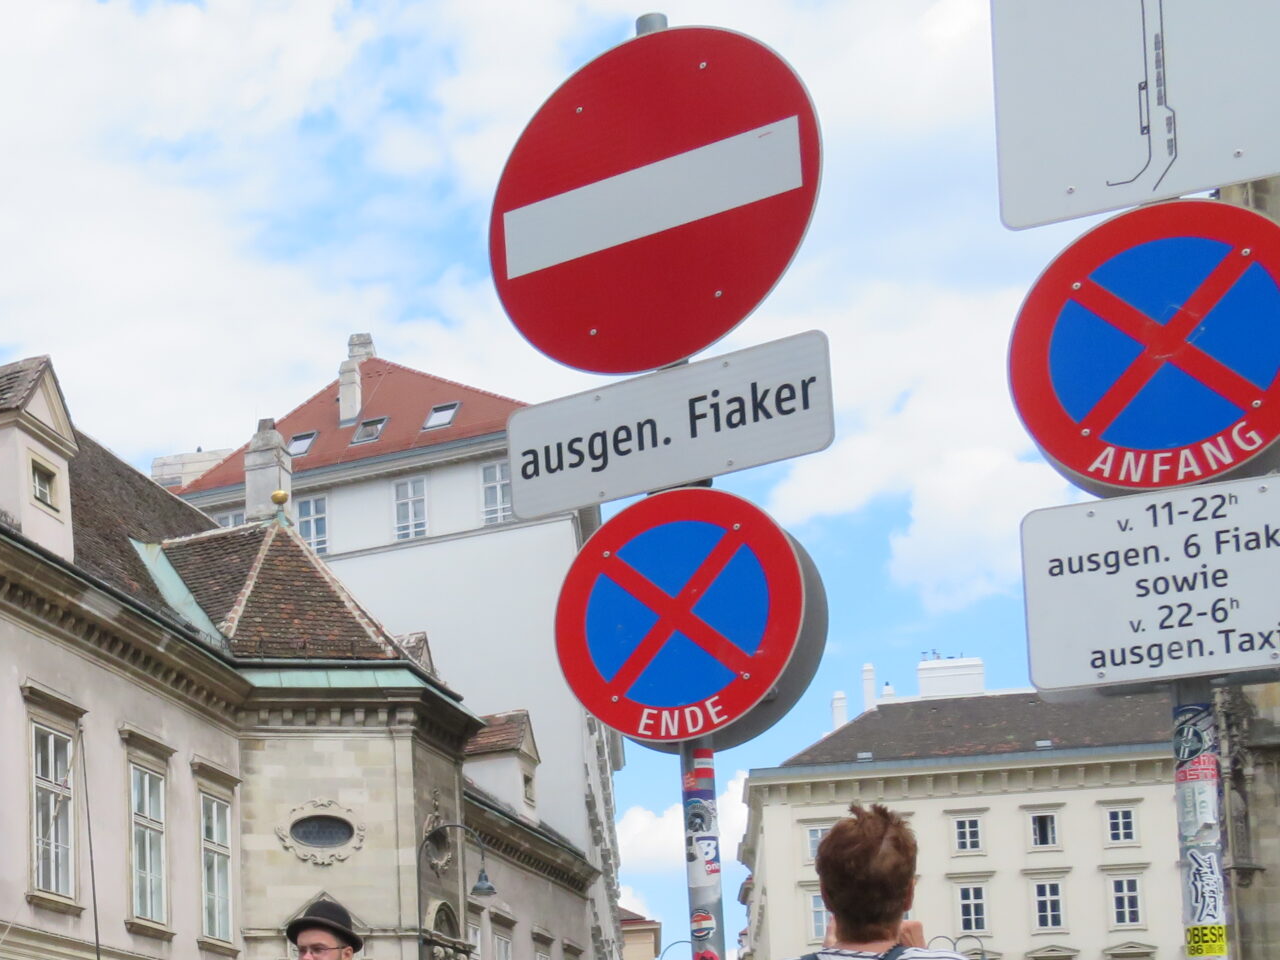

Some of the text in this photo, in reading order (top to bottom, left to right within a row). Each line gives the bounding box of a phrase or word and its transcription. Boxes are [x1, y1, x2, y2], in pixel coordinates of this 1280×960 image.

[520, 375, 817, 480] ausgen. Fiaker
[1086, 420, 1264, 484] ANFANG
[1116, 518, 1134, 532] v.
[1047, 543, 1171, 578] ausgen.
[1183, 533, 1201, 559] 6
[1135, 563, 1229, 598] sowie
[1129, 619, 1147, 633] v.
[637, 695, 729, 737] ENDE
